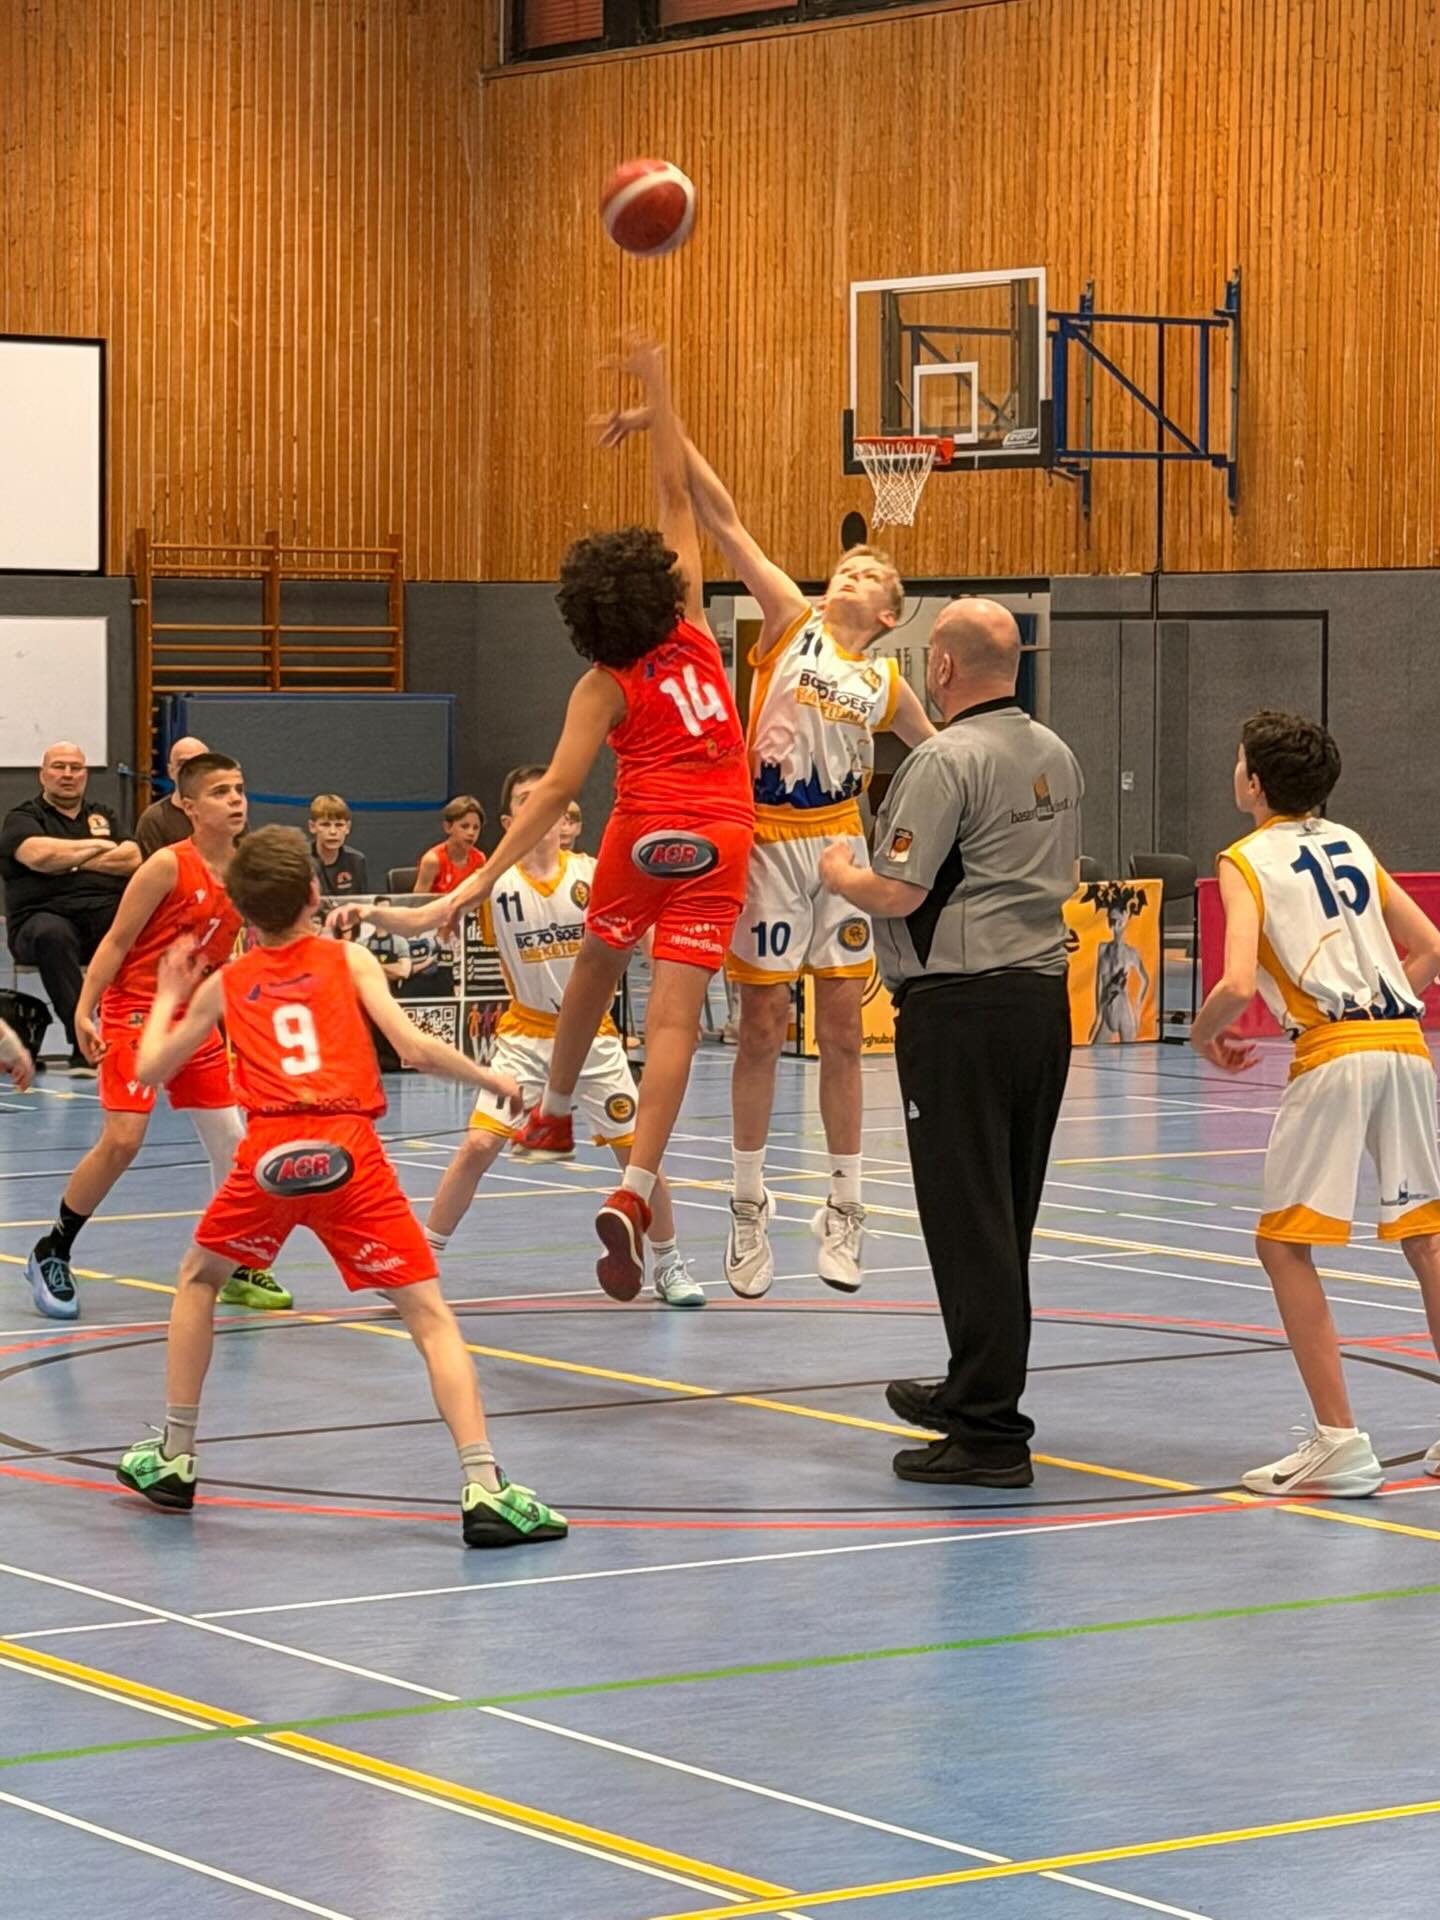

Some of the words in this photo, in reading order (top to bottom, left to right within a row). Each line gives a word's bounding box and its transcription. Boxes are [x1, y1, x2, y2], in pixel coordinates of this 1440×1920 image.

[660, 664, 728, 737] 14
[1290, 840, 1370, 919] 15
[496, 891, 525, 923] 11
[516, 935, 534, 949] BC
[537, 932, 554, 946] 70
[751, 921, 791, 957] 10
[272, 1003, 322, 1076] 9
